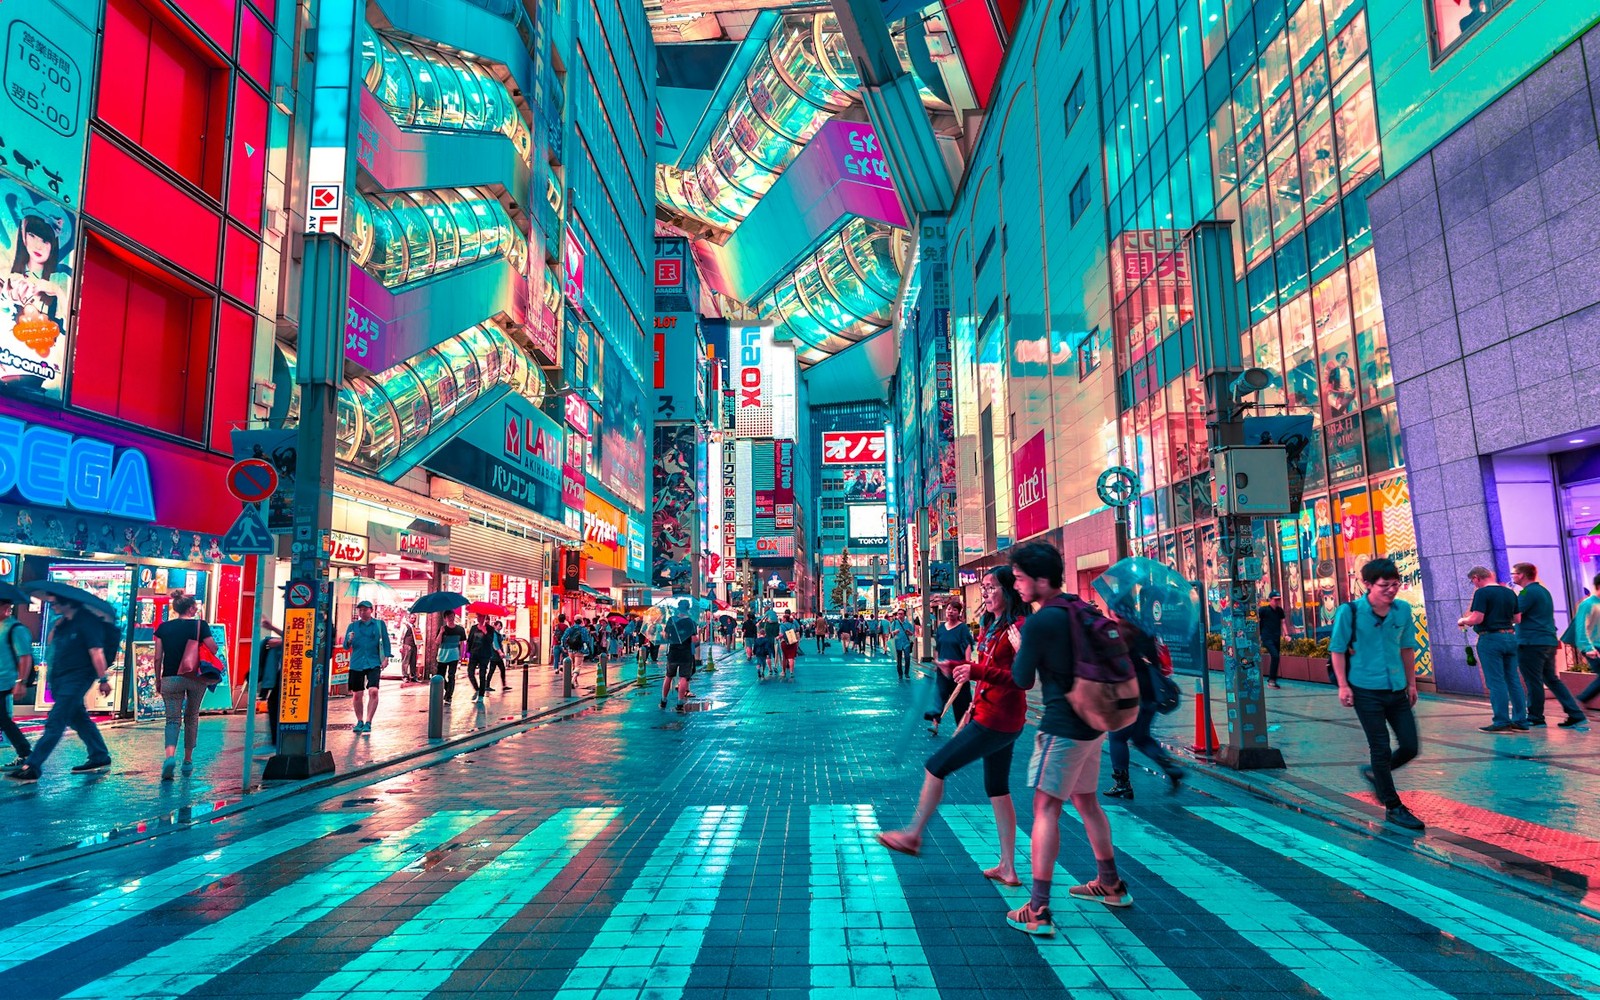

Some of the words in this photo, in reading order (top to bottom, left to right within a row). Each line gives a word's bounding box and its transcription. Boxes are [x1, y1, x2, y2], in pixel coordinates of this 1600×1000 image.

[17, 45, 72, 94] 16:00
[22, 30, 71, 76] 営業時間
[0, 414, 157, 522] SEGA
[525, 418, 563, 470] LABI
[1018, 467, 1040, 508] atré
[857, 537, 885, 545] TOKYO
[288, 616, 305, 719] 路上喫煙禁止です。
